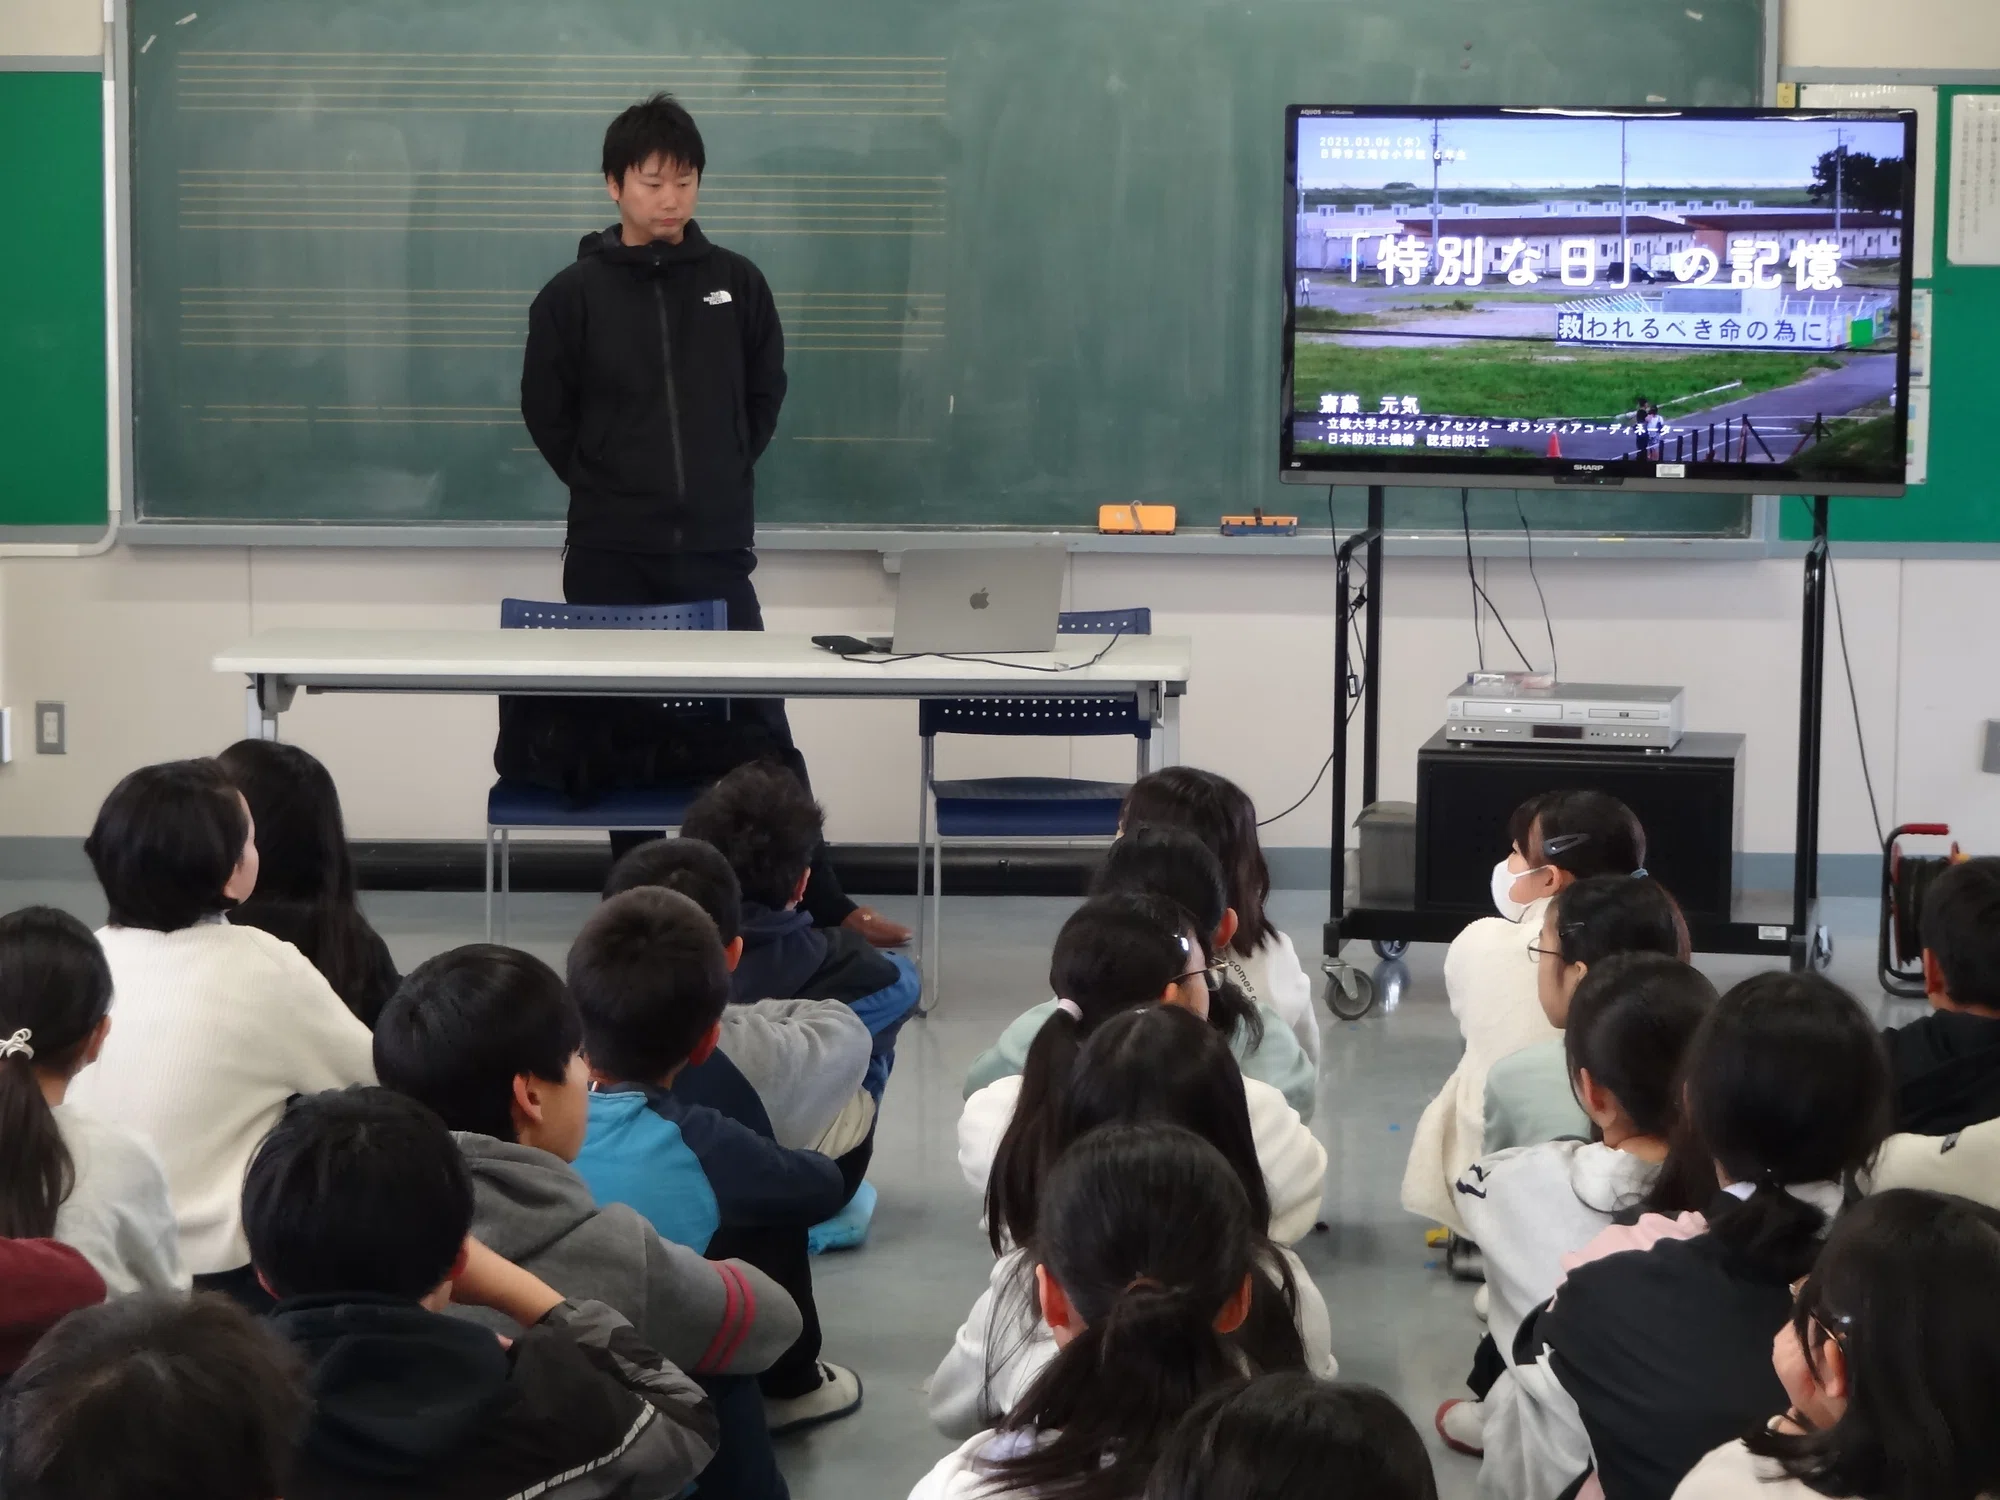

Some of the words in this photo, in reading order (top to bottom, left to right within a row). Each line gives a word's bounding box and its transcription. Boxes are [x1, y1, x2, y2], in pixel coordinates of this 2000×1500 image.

[1426, 435, 1490, 448] 認定防災士
[1228, 960, 1255, 993] comes
